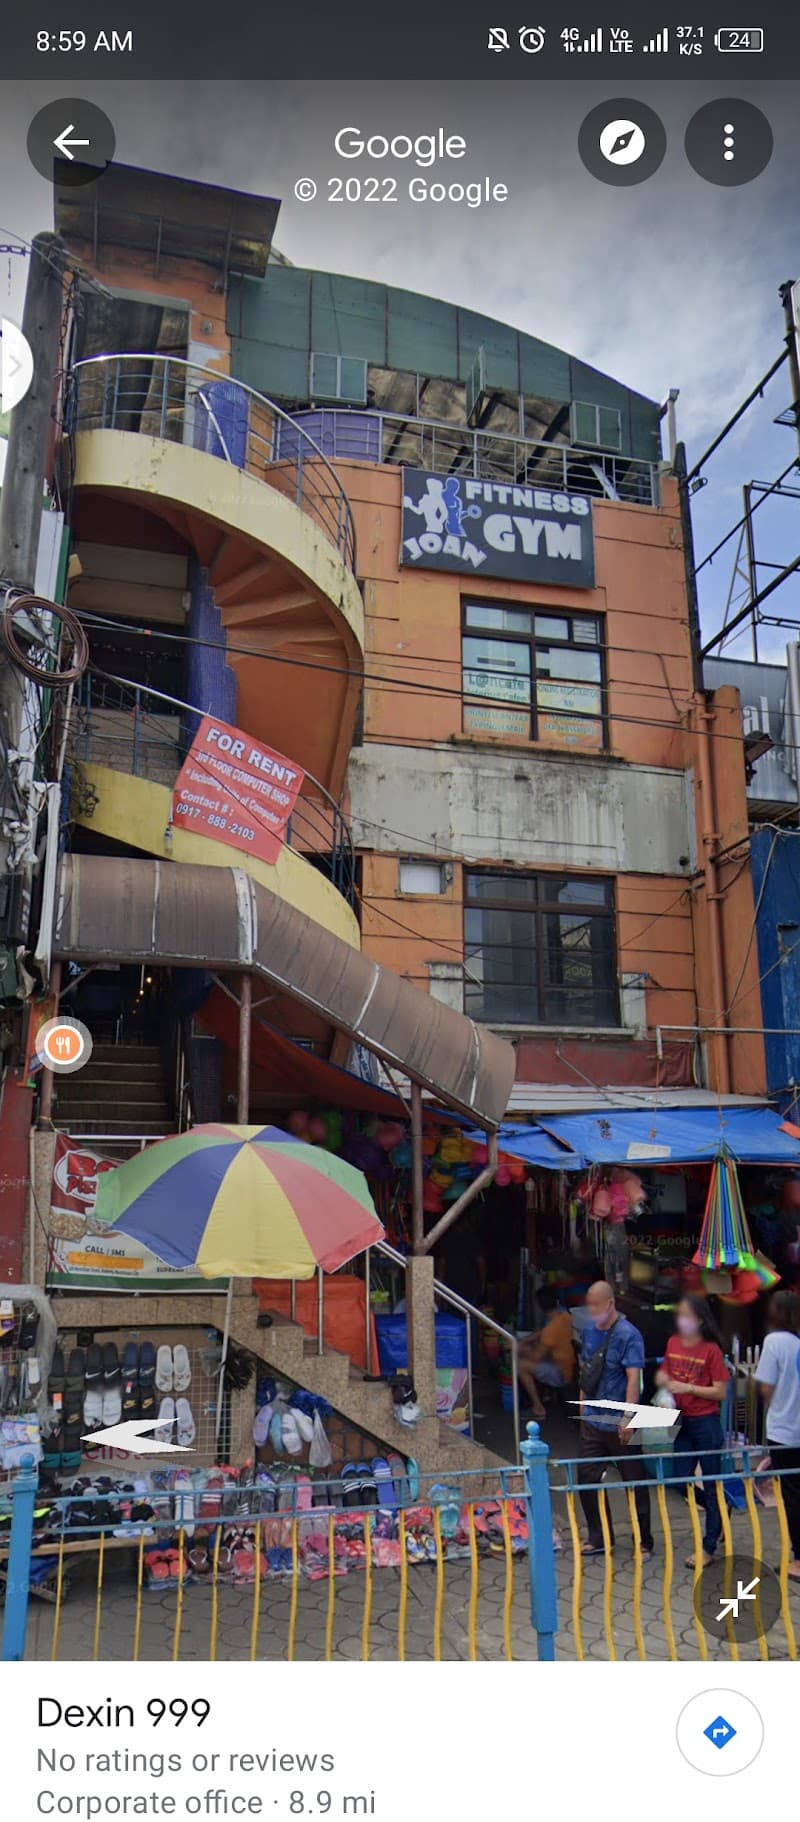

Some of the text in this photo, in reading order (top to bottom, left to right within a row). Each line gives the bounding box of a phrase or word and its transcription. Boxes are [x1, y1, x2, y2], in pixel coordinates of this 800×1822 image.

[464, 480, 590, 516] FITNESS
[403, 532, 488, 568] JOAN
[482, 512, 583, 561] GYM
[205, 727, 297, 787] FOR RENT
[208, 754, 232, 778] FLOOR
[231, 768, 272, 797] COMPUTER
[270, 789, 291, 807] SHOP
[176, 803, 201, 820] 0917
[207, 814, 227, 830] 888
[180, 789, 220, 812] Contact
[84, 1244, 105, 1256] CALL
[111, 1248, 126, 1257] SMS
